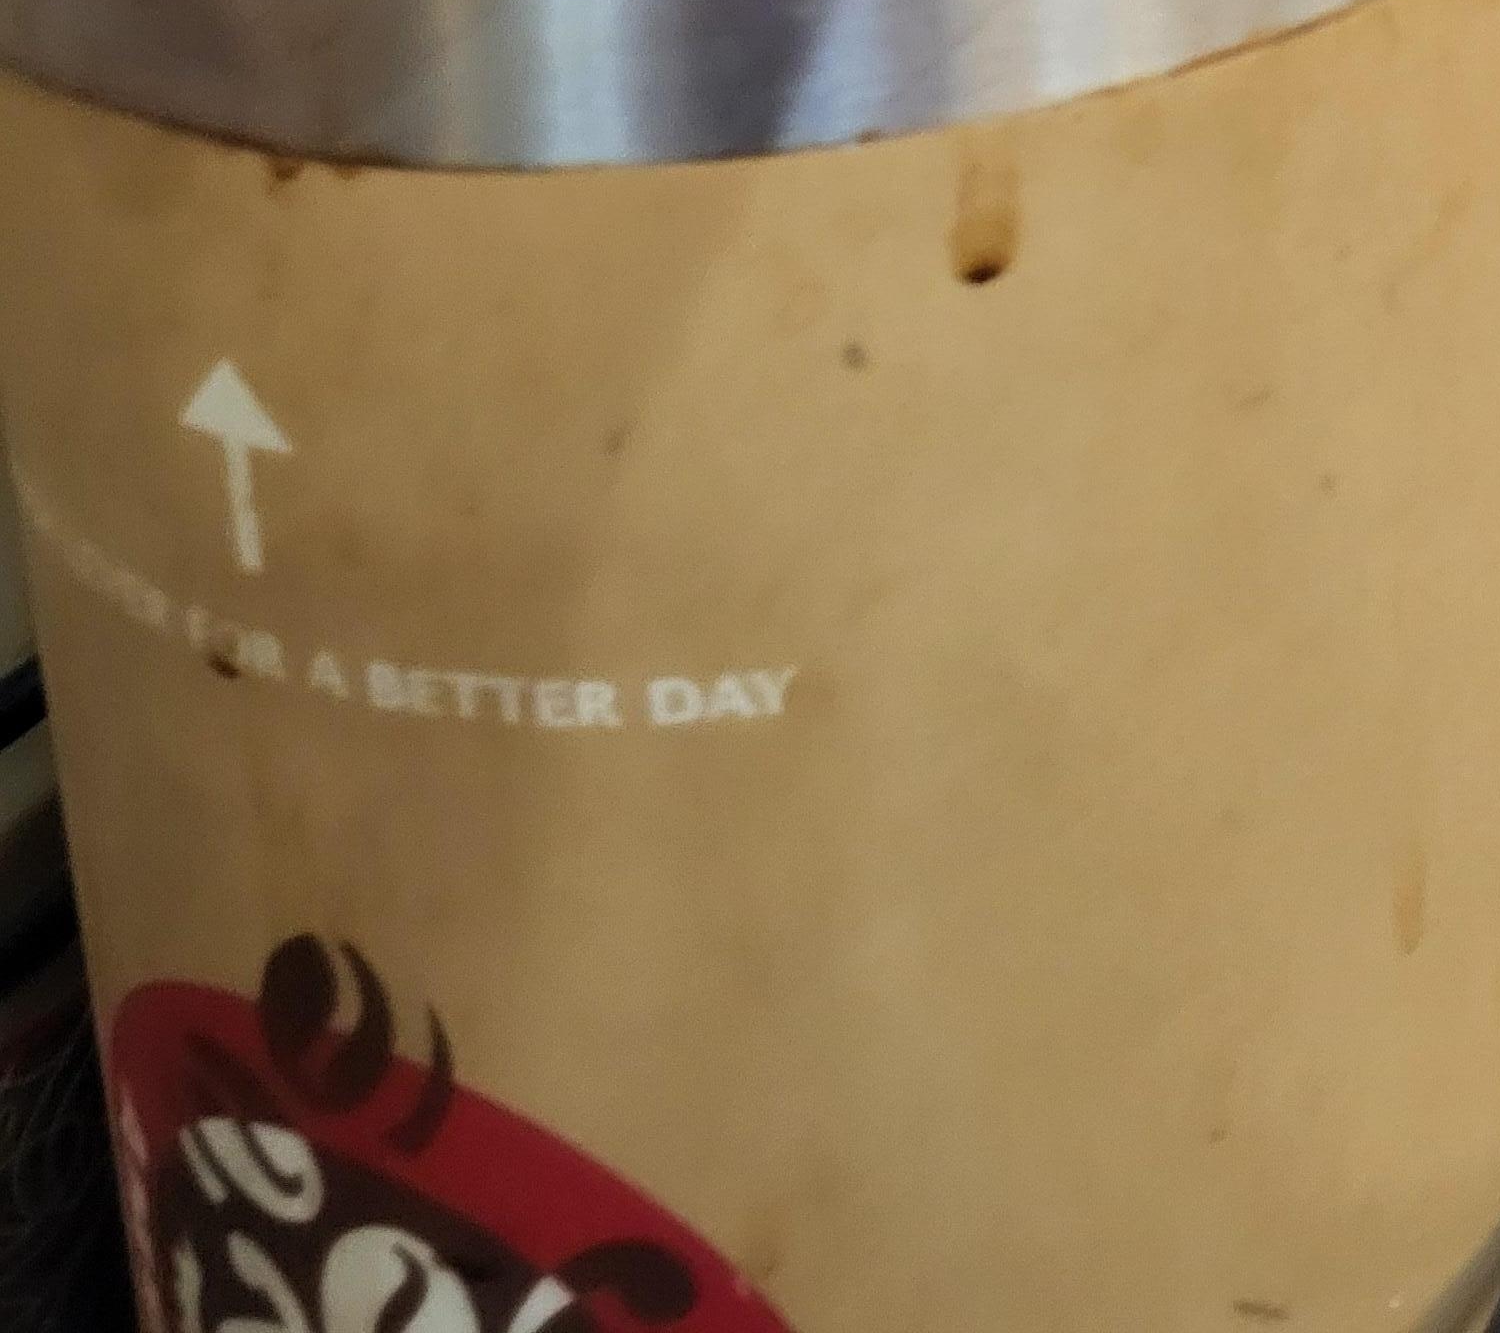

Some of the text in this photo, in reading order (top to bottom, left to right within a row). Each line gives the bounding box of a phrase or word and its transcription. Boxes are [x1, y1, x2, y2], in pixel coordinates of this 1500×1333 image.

[309, 645, 350, 701] A
[366, 658, 622, 728] BETTER
[645, 664, 798, 728] DAY
